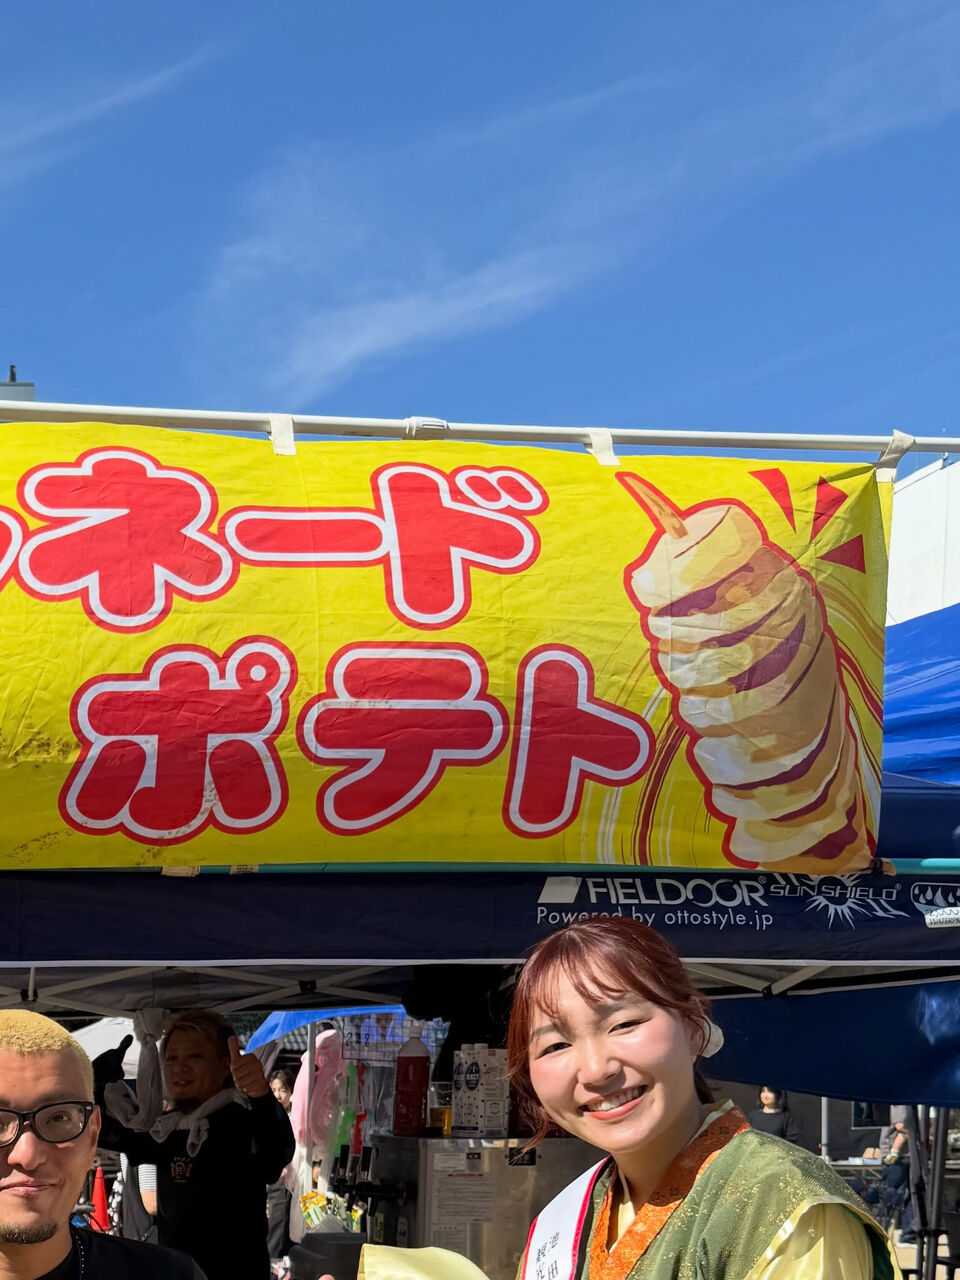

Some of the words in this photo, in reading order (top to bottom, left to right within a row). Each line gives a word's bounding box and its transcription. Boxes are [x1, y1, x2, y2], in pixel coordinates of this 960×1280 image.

[58, 635, 656, 846] ポテト
[585, 878, 768, 907] FIELDOOR
[632, 906, 655, 927] by
[664, 907, 774, 931] ottostyle.jp
